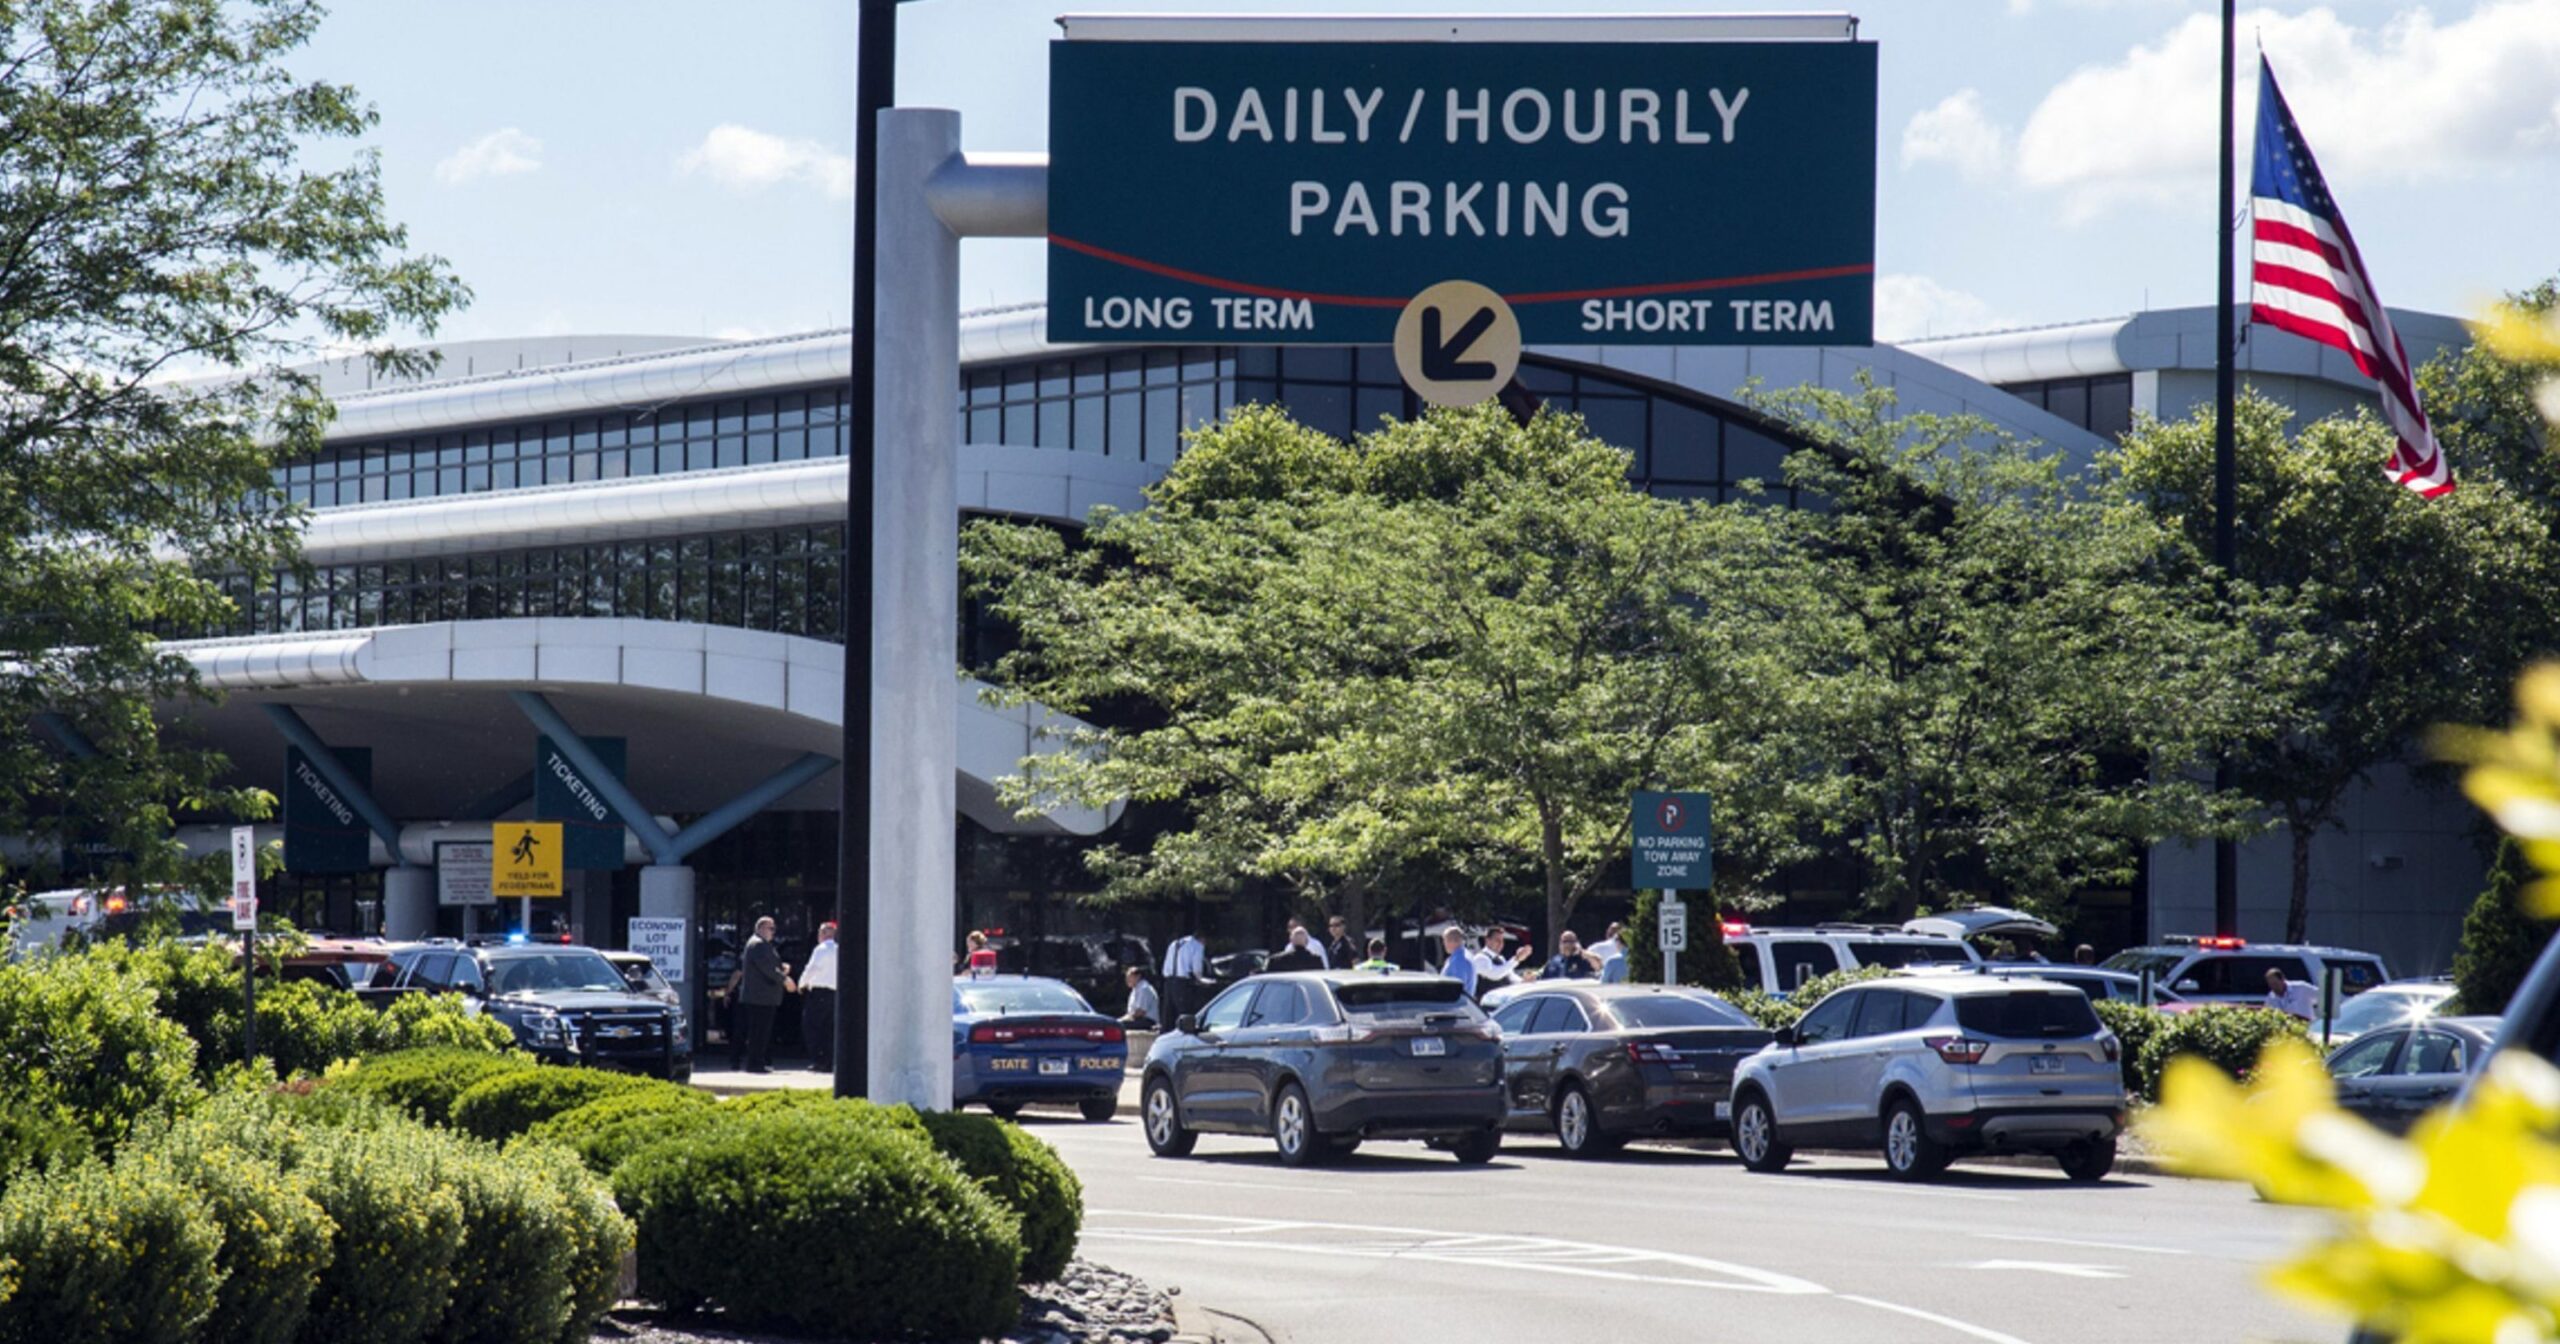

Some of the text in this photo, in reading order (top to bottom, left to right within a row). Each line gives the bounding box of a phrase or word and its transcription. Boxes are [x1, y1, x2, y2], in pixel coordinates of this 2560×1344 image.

[1290, 180, 1630, 238] PARKING
[1084, 296, 1314, 330] LONG TERM
[1581, 299, 1836, 333] SHORT TERM
[547, 751, 608, 821] TICKETING
[295, 761, 353, 825] TICKETING
[1637, 836, 1705, 849] NO PARKING
[1643, 850, 1701, 863] TOW AWAY
[1657, 865, 1688, 877] ZONE
[1662, 908, 1684, 916] SPEED
[631, 921, 683, 931] ECONOMY
[1664, 918, 1681, 926] LIMIT
[645, 933, 668, 943] LOT
[1663, 928, 1682, 945] 15
[632, 945, 680, 955] SHUTTLE
[991, 1057, 1030, 1070] STATE
[1079, 1057, 1121, 1070] POLICE
